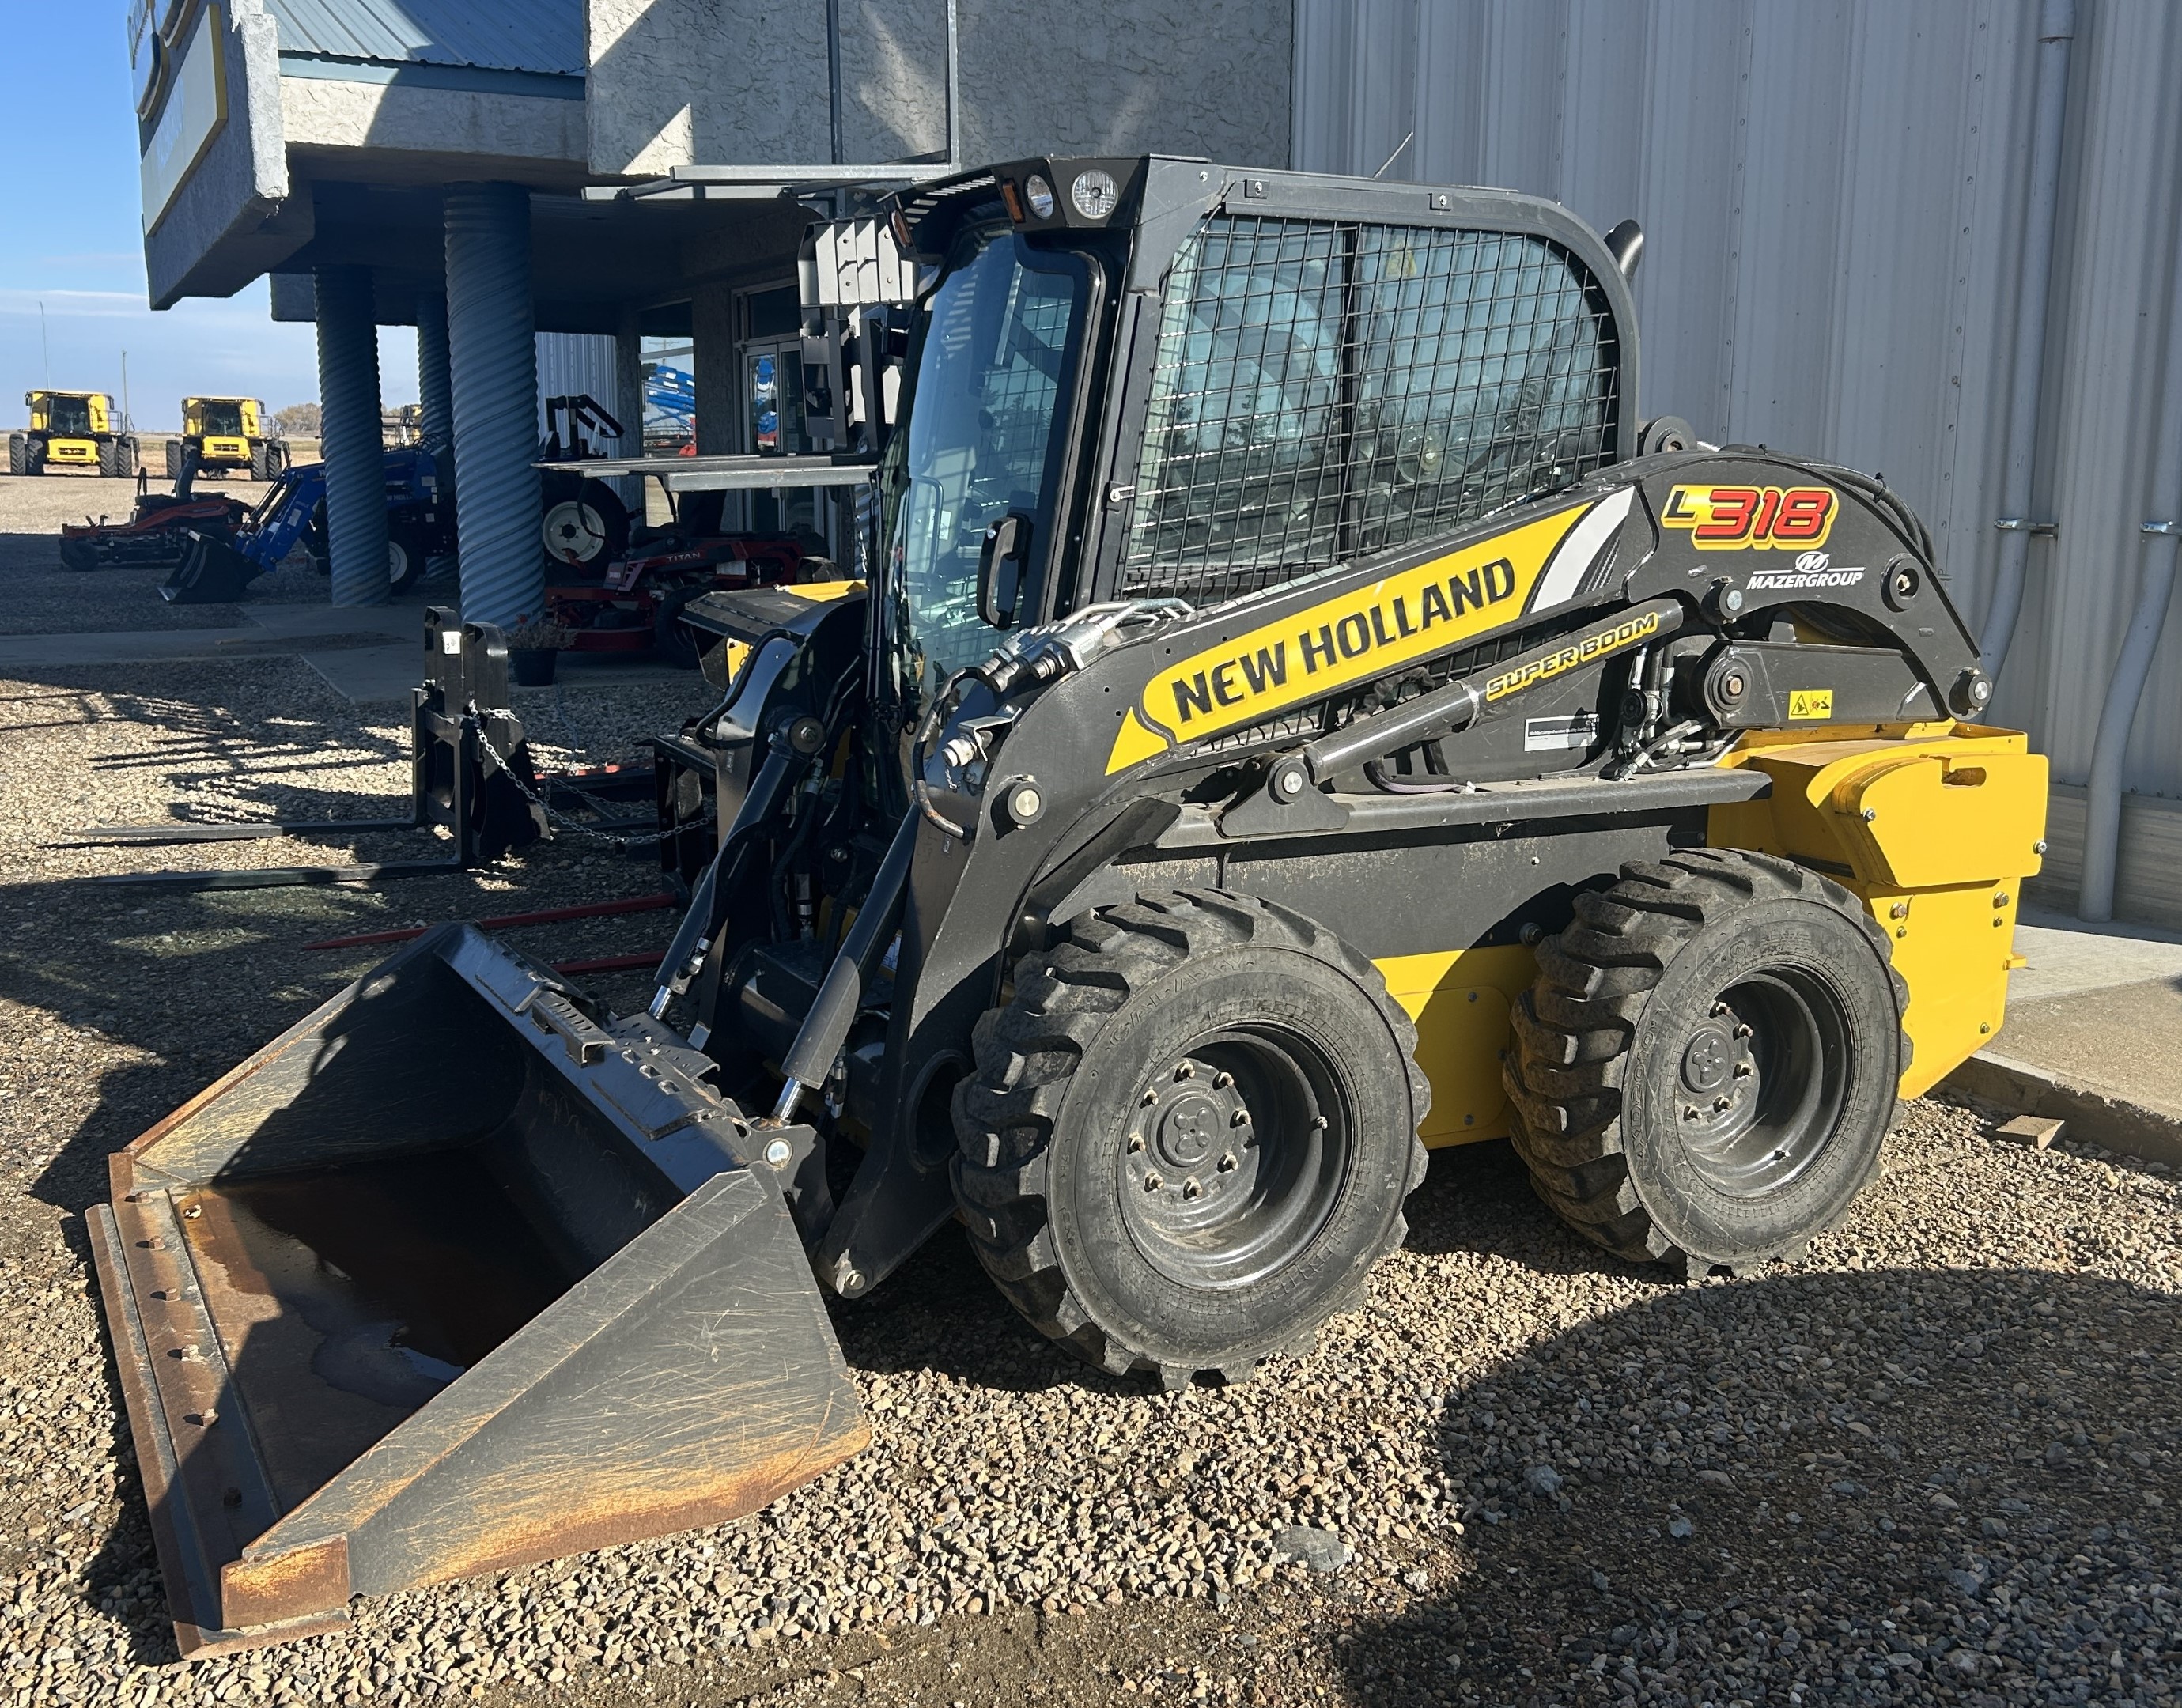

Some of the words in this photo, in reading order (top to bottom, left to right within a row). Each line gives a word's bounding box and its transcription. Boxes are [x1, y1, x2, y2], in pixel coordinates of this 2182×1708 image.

[666, 551, 701, 564] TITAN
[1745, 572, 1864, 591] MAZERGROUP
[1171, 640, 1288, 724] NEW
[1298, 557, 1517, 676] HOLLAND
[1488, 648, 1577, 699] SUPER
[1581, 613, 1657, 659] BOOM
